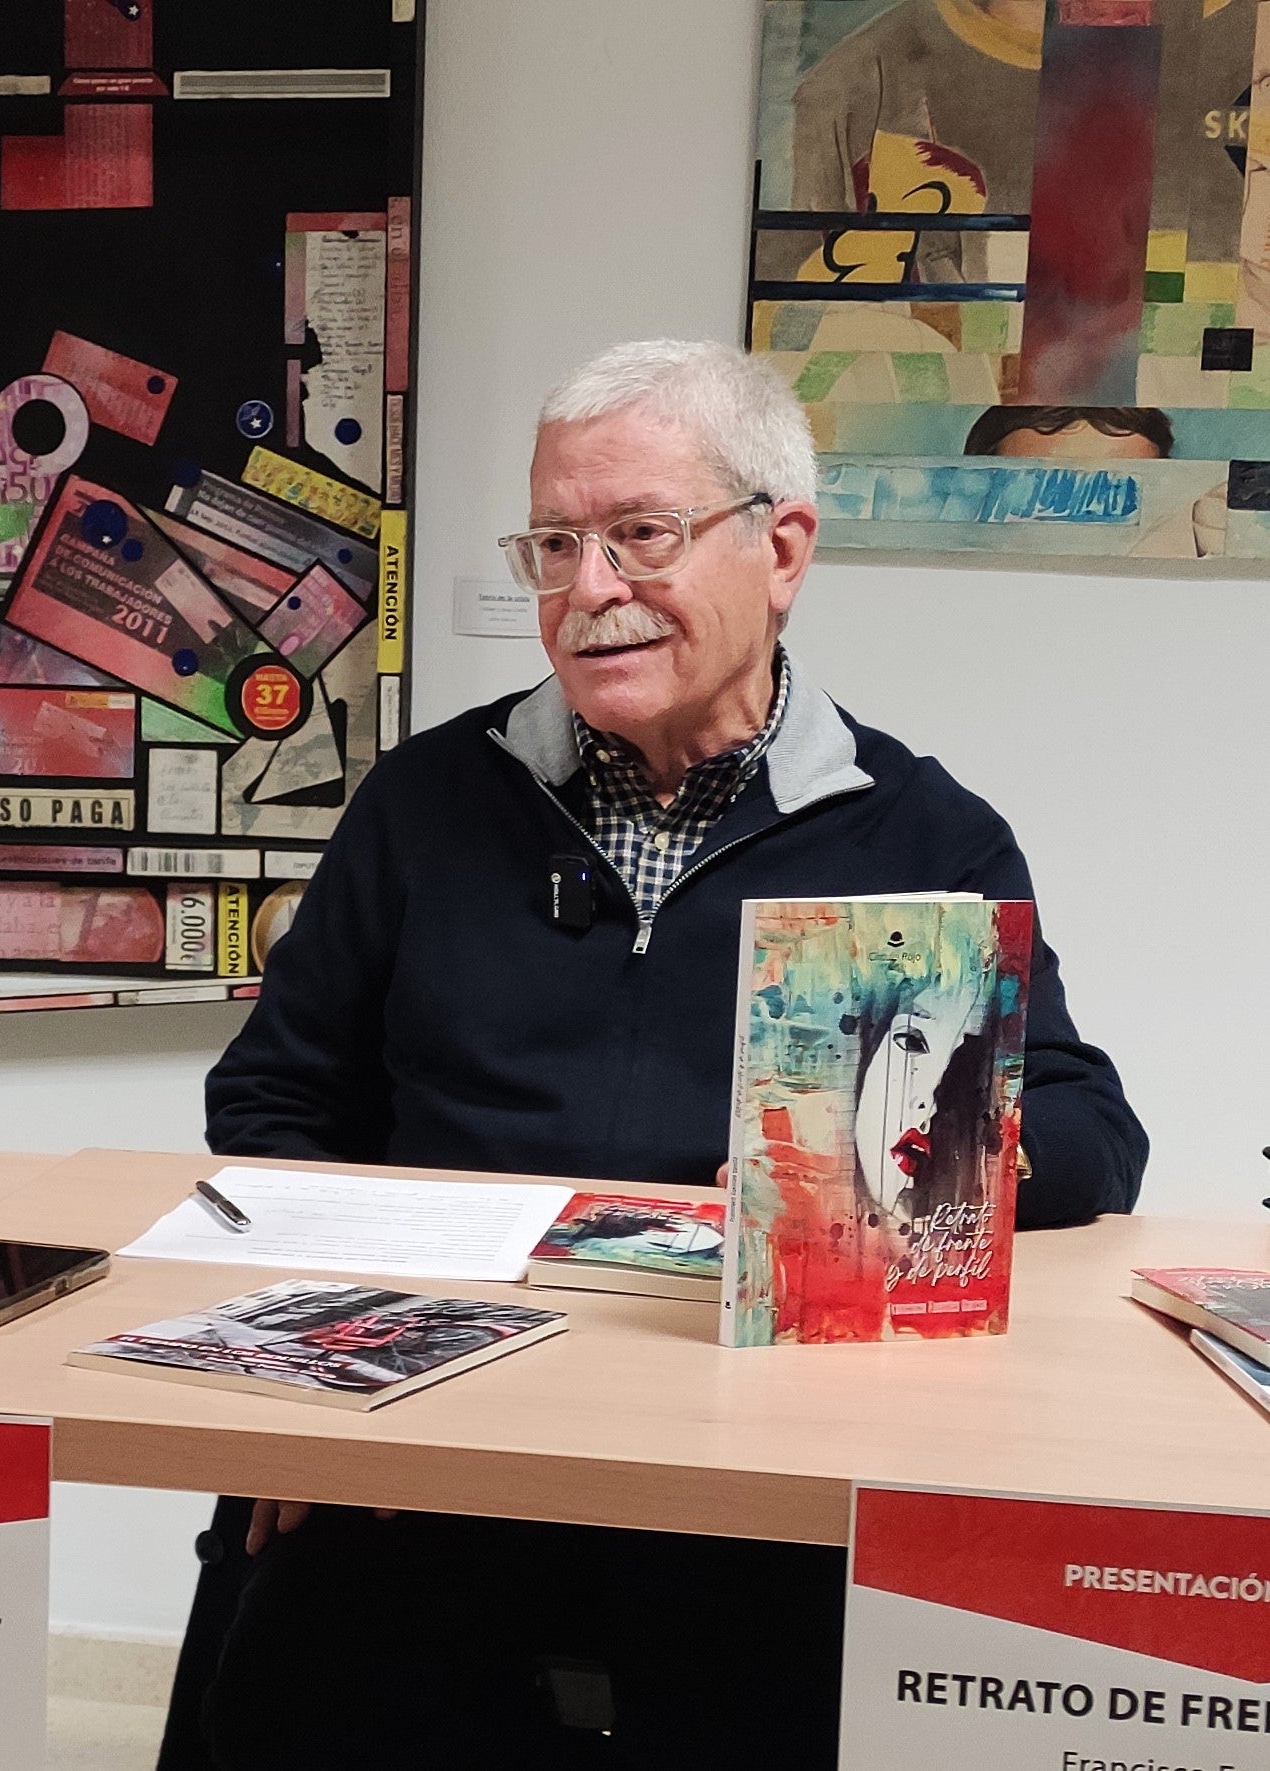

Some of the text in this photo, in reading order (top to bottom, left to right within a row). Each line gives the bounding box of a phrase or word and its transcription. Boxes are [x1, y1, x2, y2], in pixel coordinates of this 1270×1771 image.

[382, 544, 400, 642] ATENCIÓN
[111, 603, 171, 645] 2011
[255, 683, 290, 705] 37
[51, 799, 124, 825] PAGA
[226, 884, 242, 974] ATENCIÓN
[896, 1669, 1270, 1735] RETRATO DE FRE
